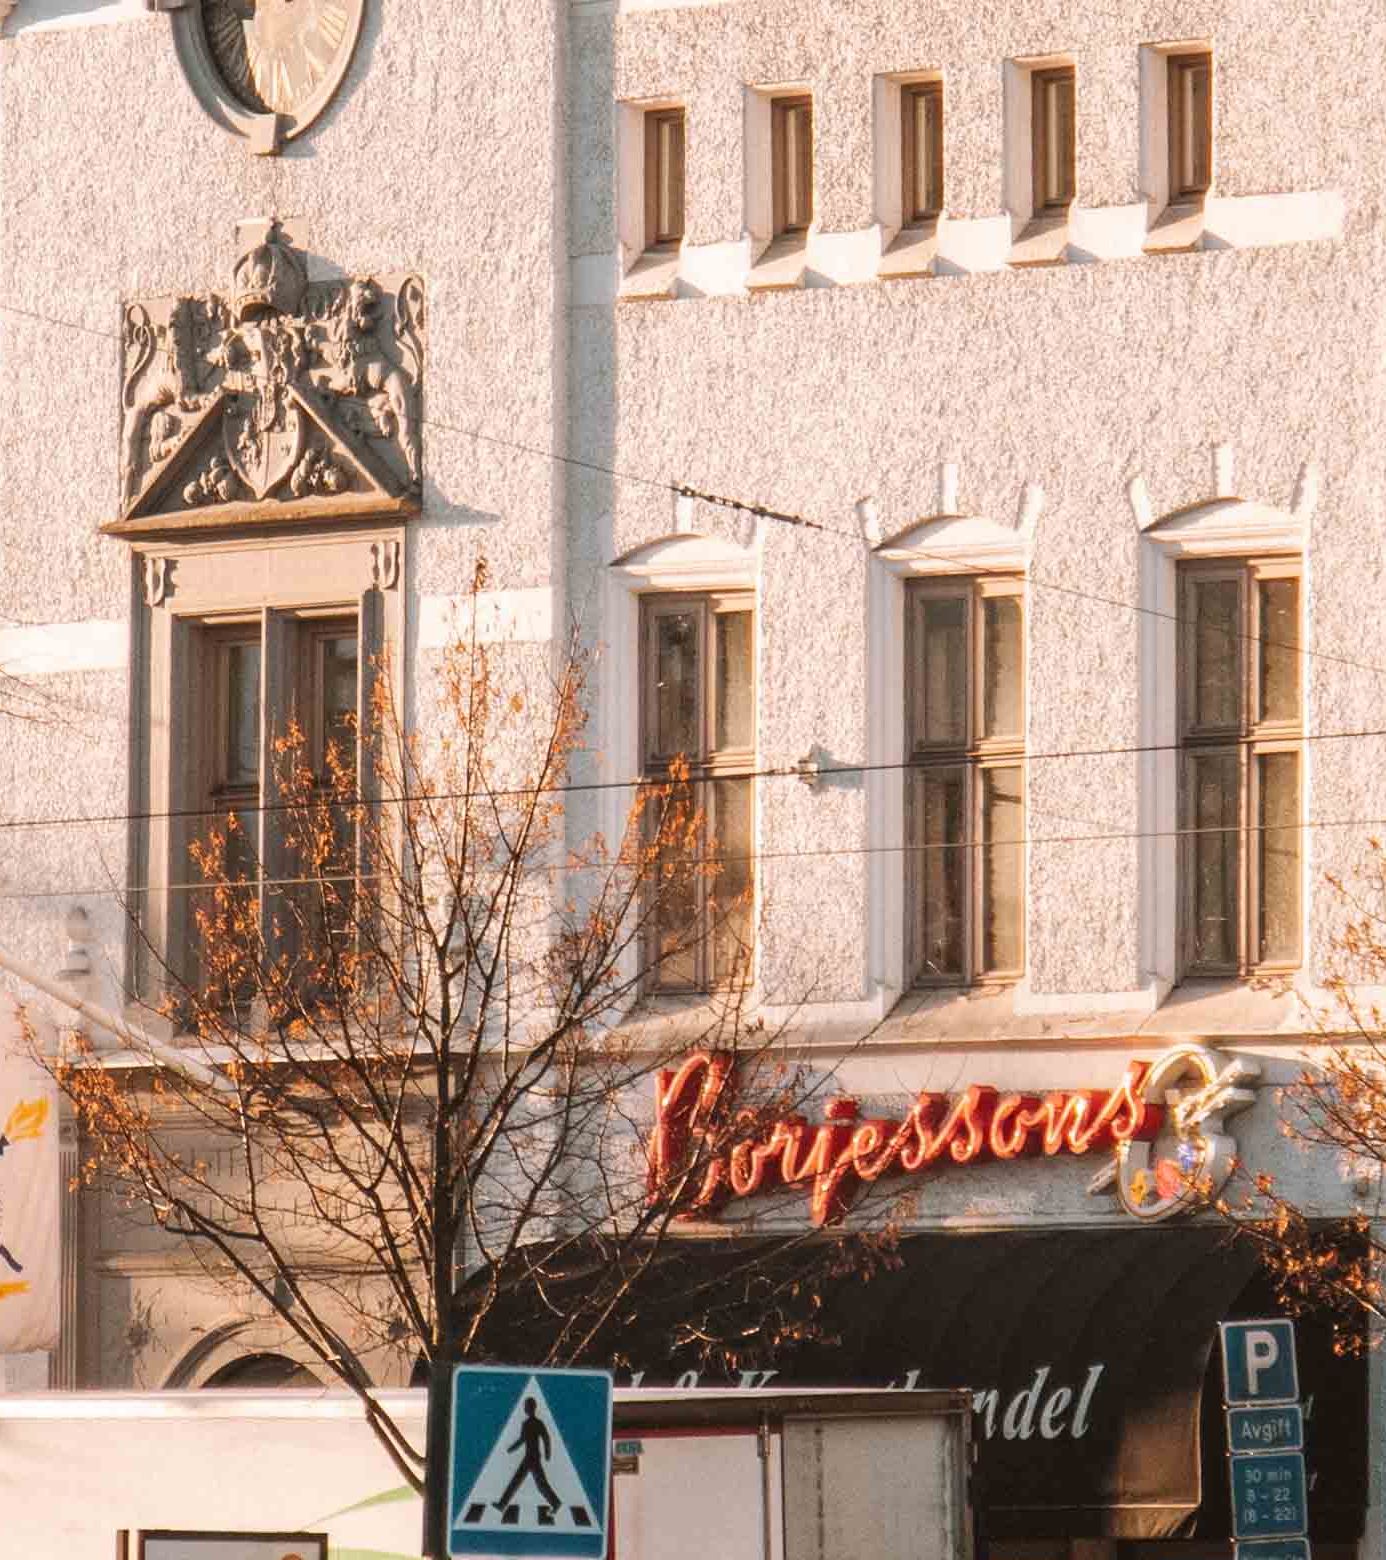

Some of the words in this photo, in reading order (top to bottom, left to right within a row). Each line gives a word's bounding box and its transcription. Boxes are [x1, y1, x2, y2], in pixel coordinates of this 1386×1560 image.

[1245, 1330, 1279, 1395] P
[1241, 1419, 1292, 1443] Avgift
[1267, 1466, 1293, 1481] min
